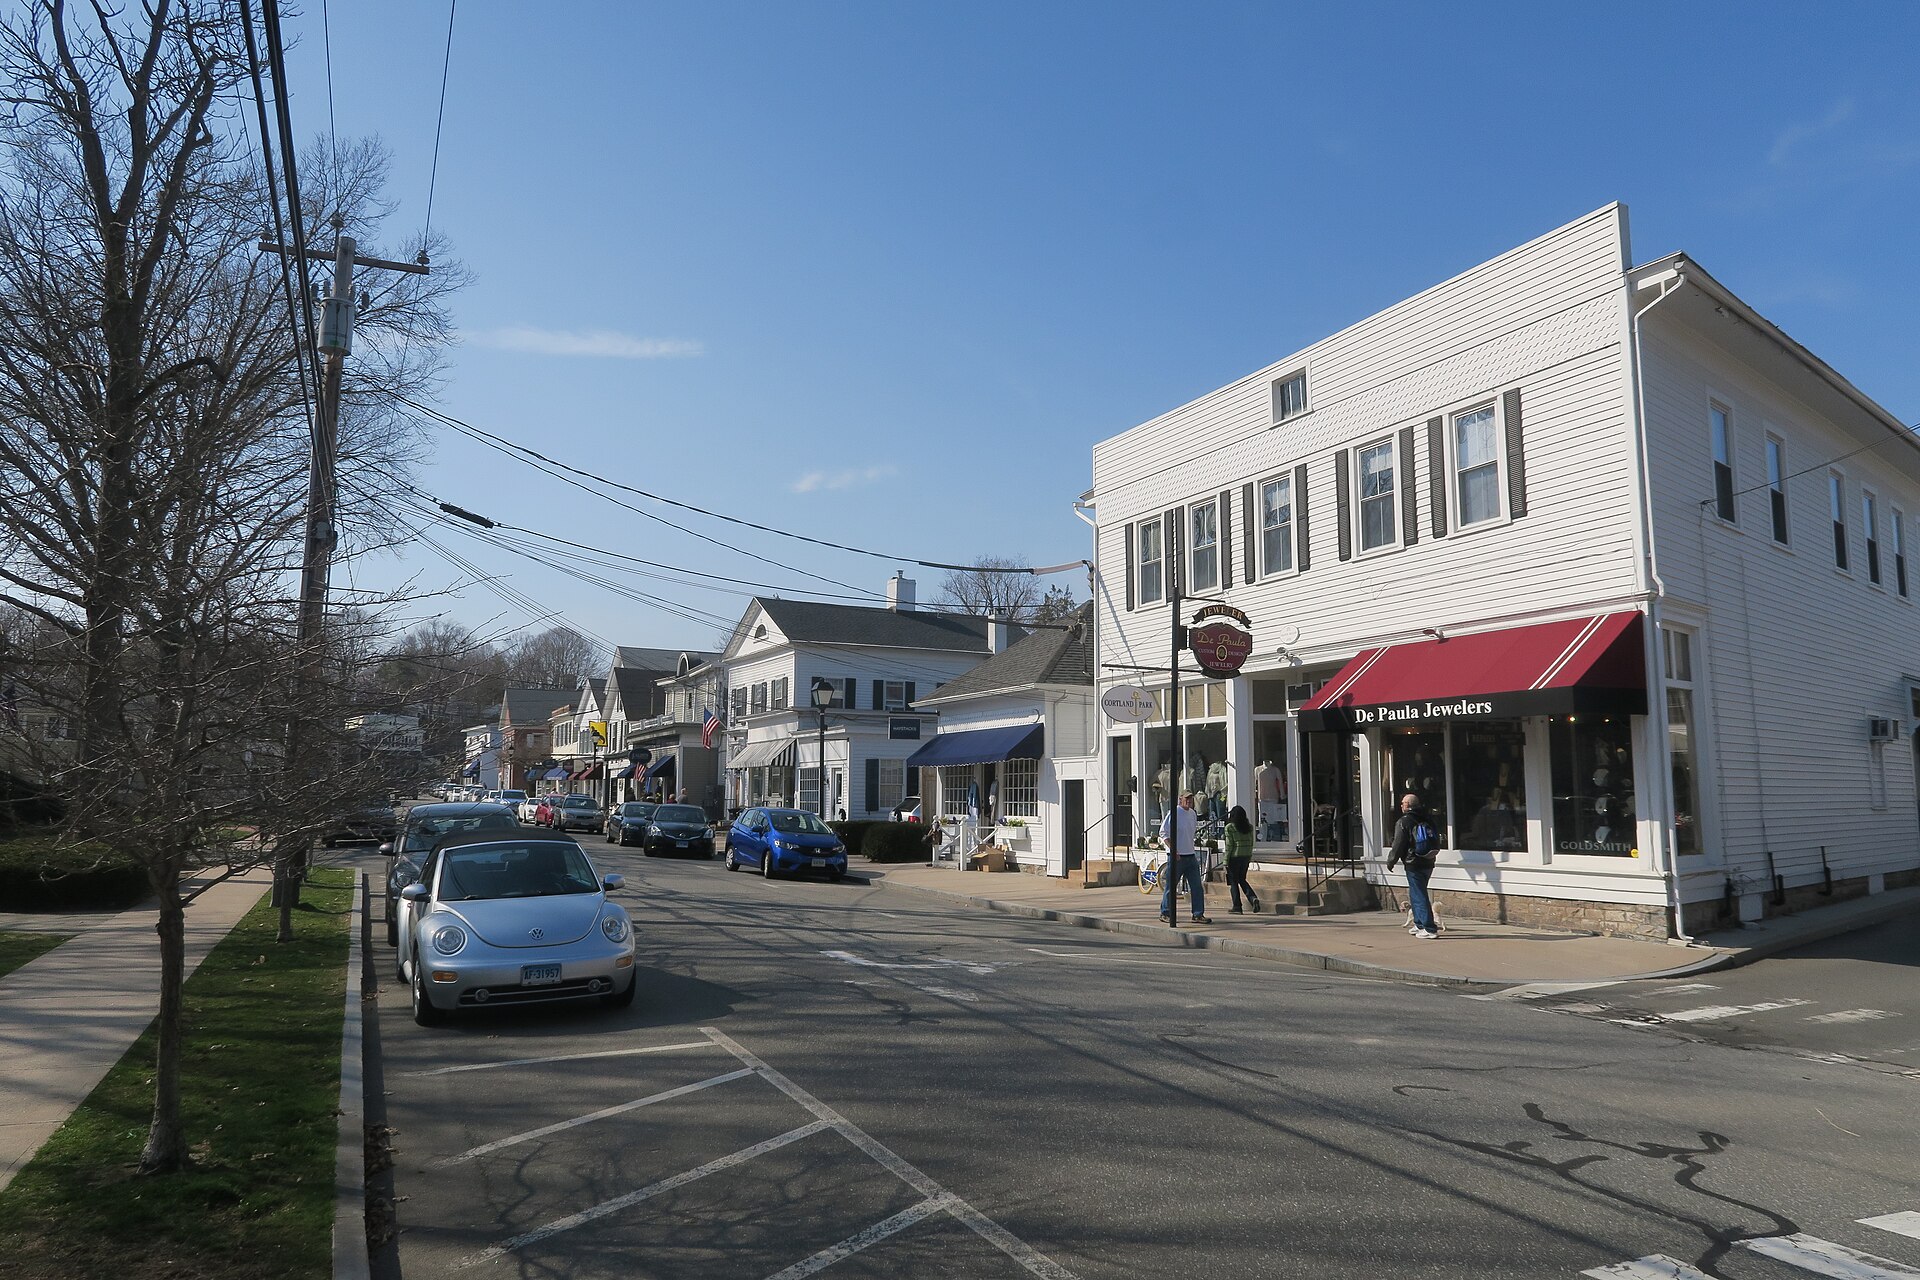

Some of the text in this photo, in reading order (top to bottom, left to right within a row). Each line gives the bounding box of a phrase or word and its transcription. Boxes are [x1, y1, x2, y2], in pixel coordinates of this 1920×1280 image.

[1203, 606, 1243, 619] JEWEER
[1197, 631, 1247, 647] De Paula
[1104, 699, 1153, 709] CORTLAND PARK
[1355, 699, 1493, 724] De Paula Jewelers
[1560, 841, 1632, 852] GOLDSMITH
